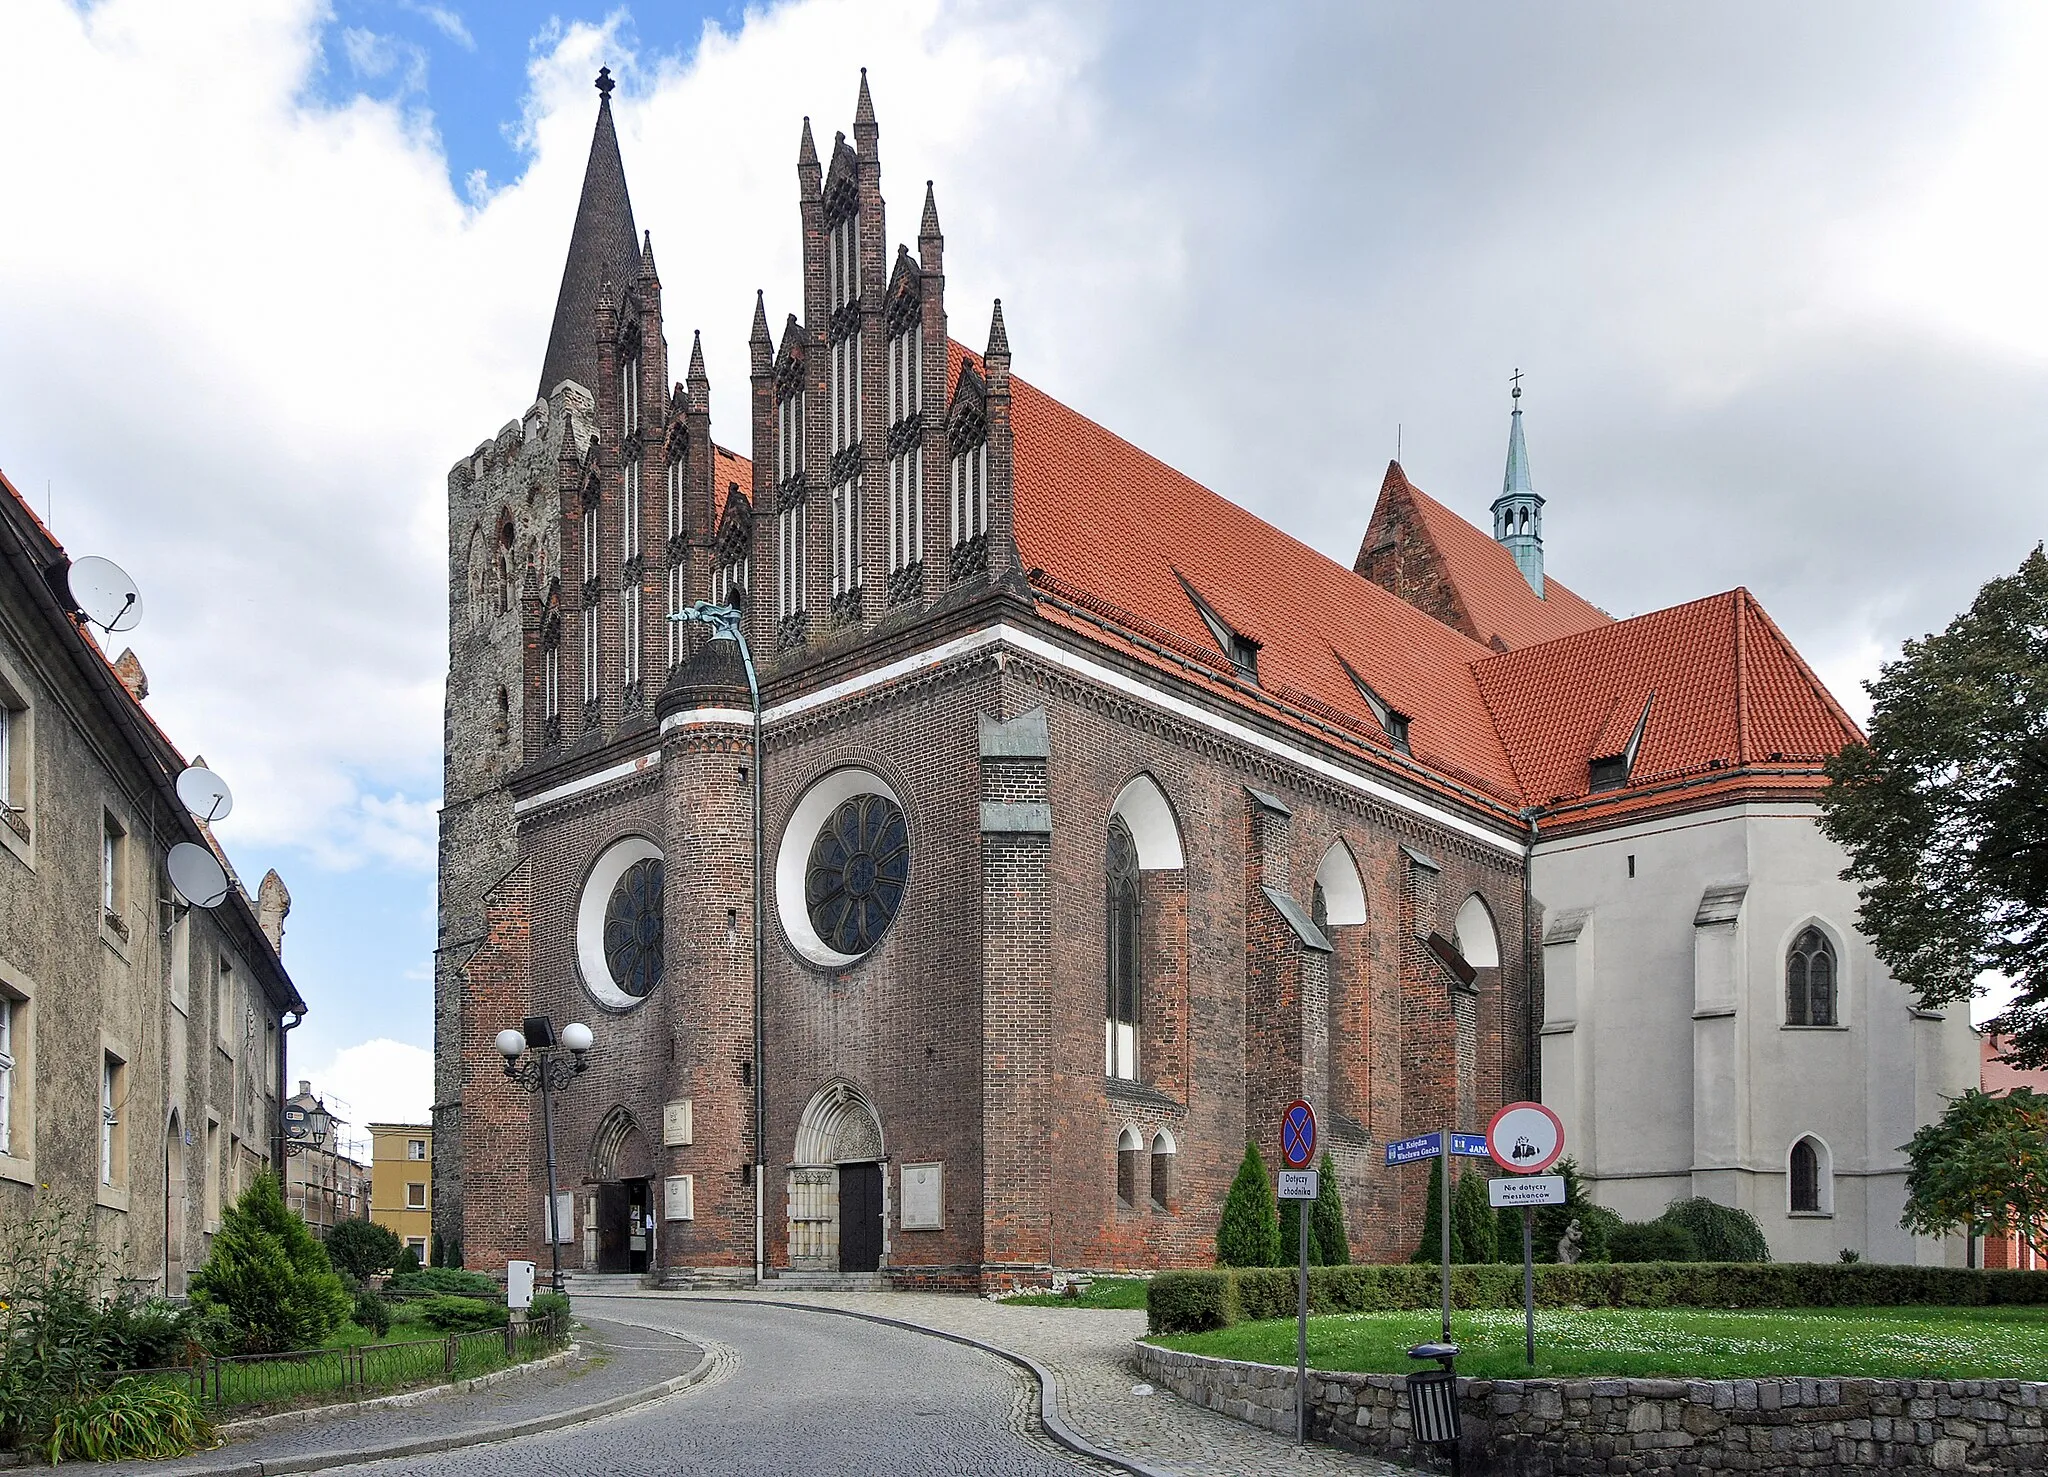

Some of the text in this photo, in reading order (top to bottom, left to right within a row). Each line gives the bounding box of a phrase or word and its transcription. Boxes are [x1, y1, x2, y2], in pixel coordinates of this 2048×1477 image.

[1397, 1139, 1428, 1151] ul. Księdza
[1469, 1144, 1490, 1154] JANA
[1285, 1174, 1308, 1185] Dotyczy
[1283, 1186, 1311, 1196] chodnika
